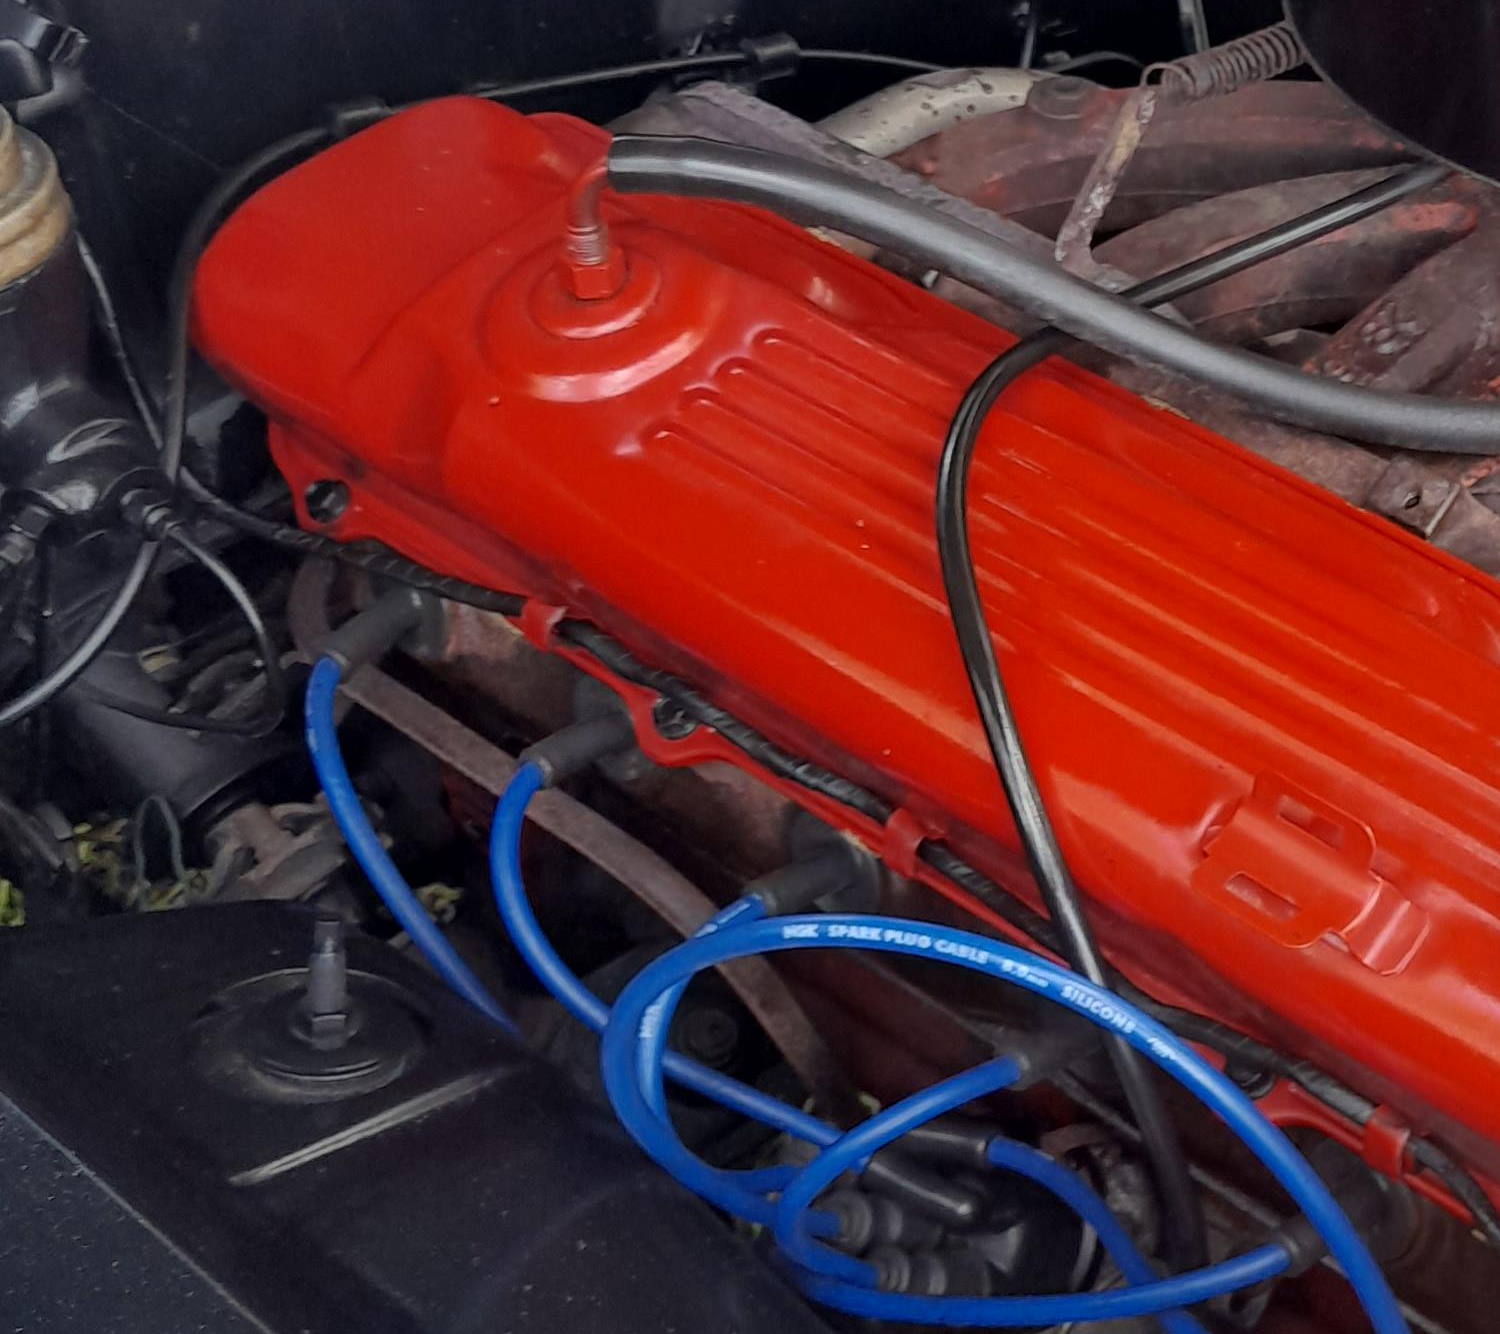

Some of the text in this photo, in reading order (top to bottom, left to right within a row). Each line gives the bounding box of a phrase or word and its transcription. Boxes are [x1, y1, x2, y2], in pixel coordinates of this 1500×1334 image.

[827, 924, 882, 942] SPARK
[884, 928, 932, 950] PLUG
[934, 939, 989, 965] CABLE
[1060, 984, 1135, 1035] SILICONE
